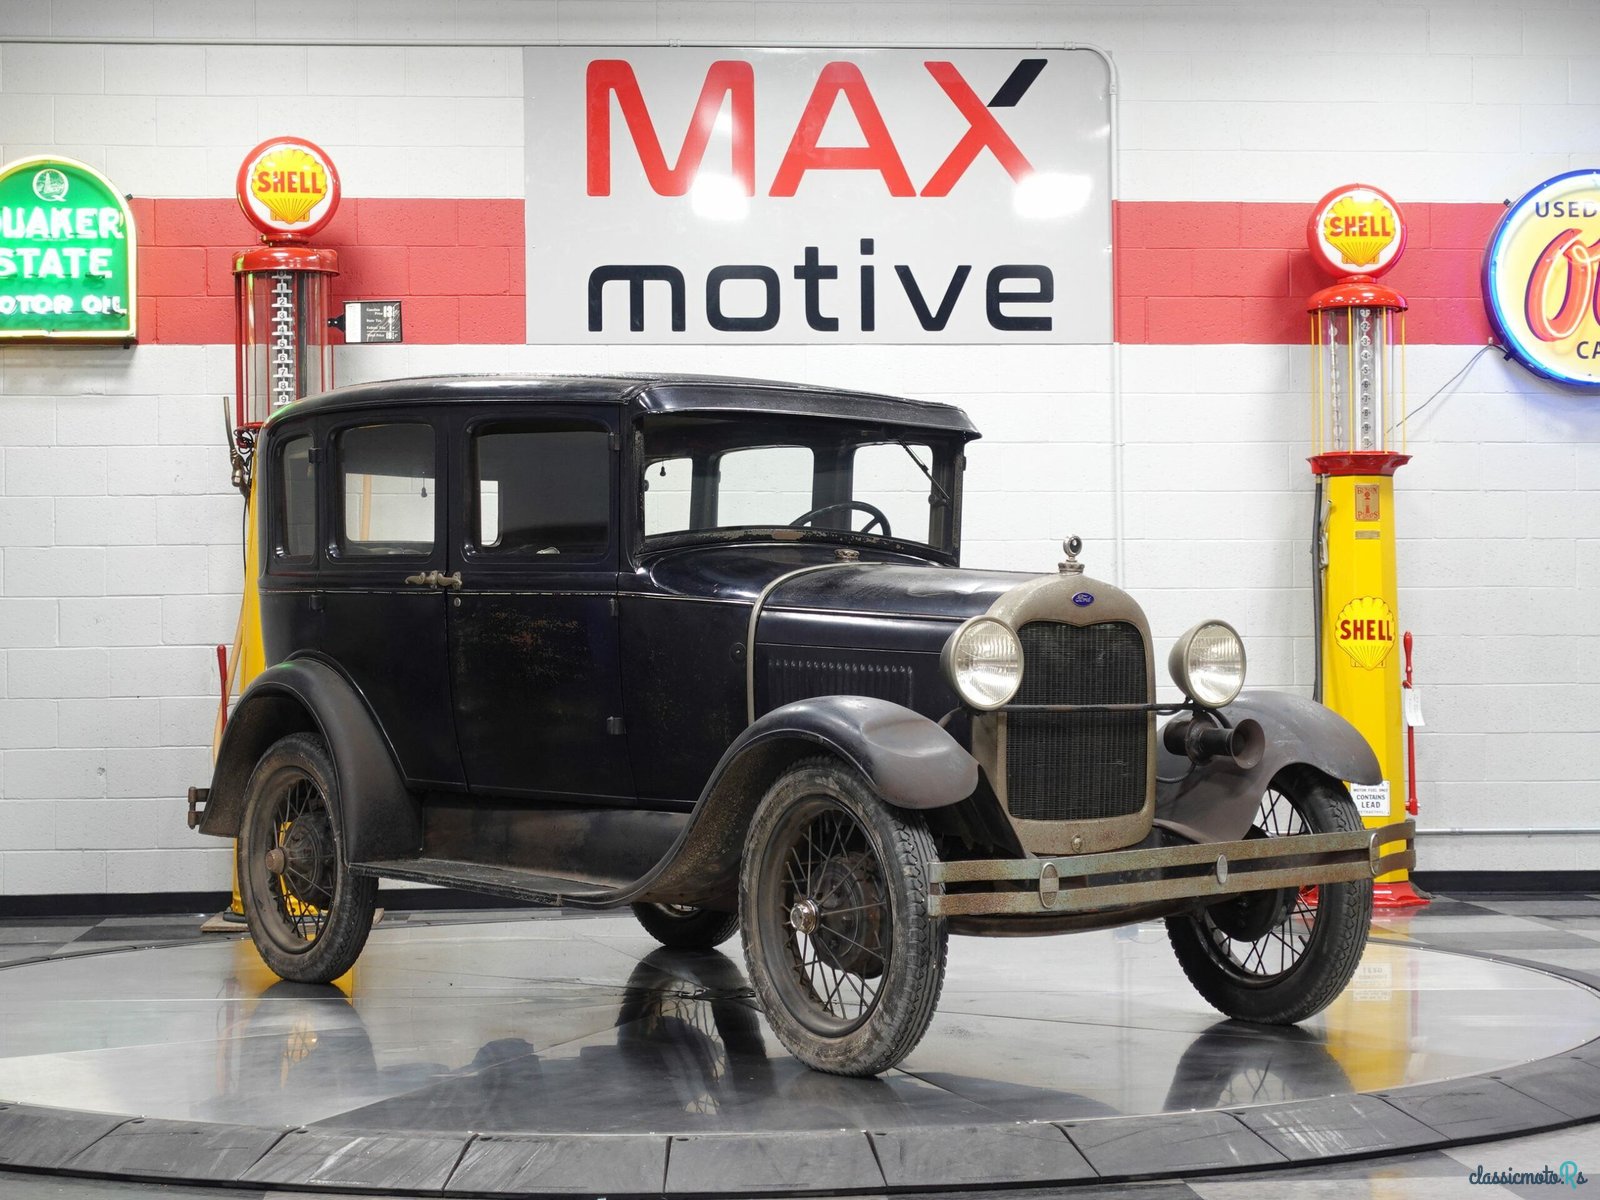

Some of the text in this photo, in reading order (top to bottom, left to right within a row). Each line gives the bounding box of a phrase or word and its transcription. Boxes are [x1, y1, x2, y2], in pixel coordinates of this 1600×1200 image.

[586, 58, 1048, 198] MAX
[257, 171, 322, 194] SHELL
[0, 205, 124, 239] UAKER
[1535, 201, 1599, 218] USED
[1329, 216, 1391, 237] SHELL
[0, 247, 113, 279] STATE
[587, 238, 1054, 332] motive
[1524, 228, 1600, 342] O
[81, 295, 127, 315] OIL
[1340, 619, 1393, 641] SHELL
